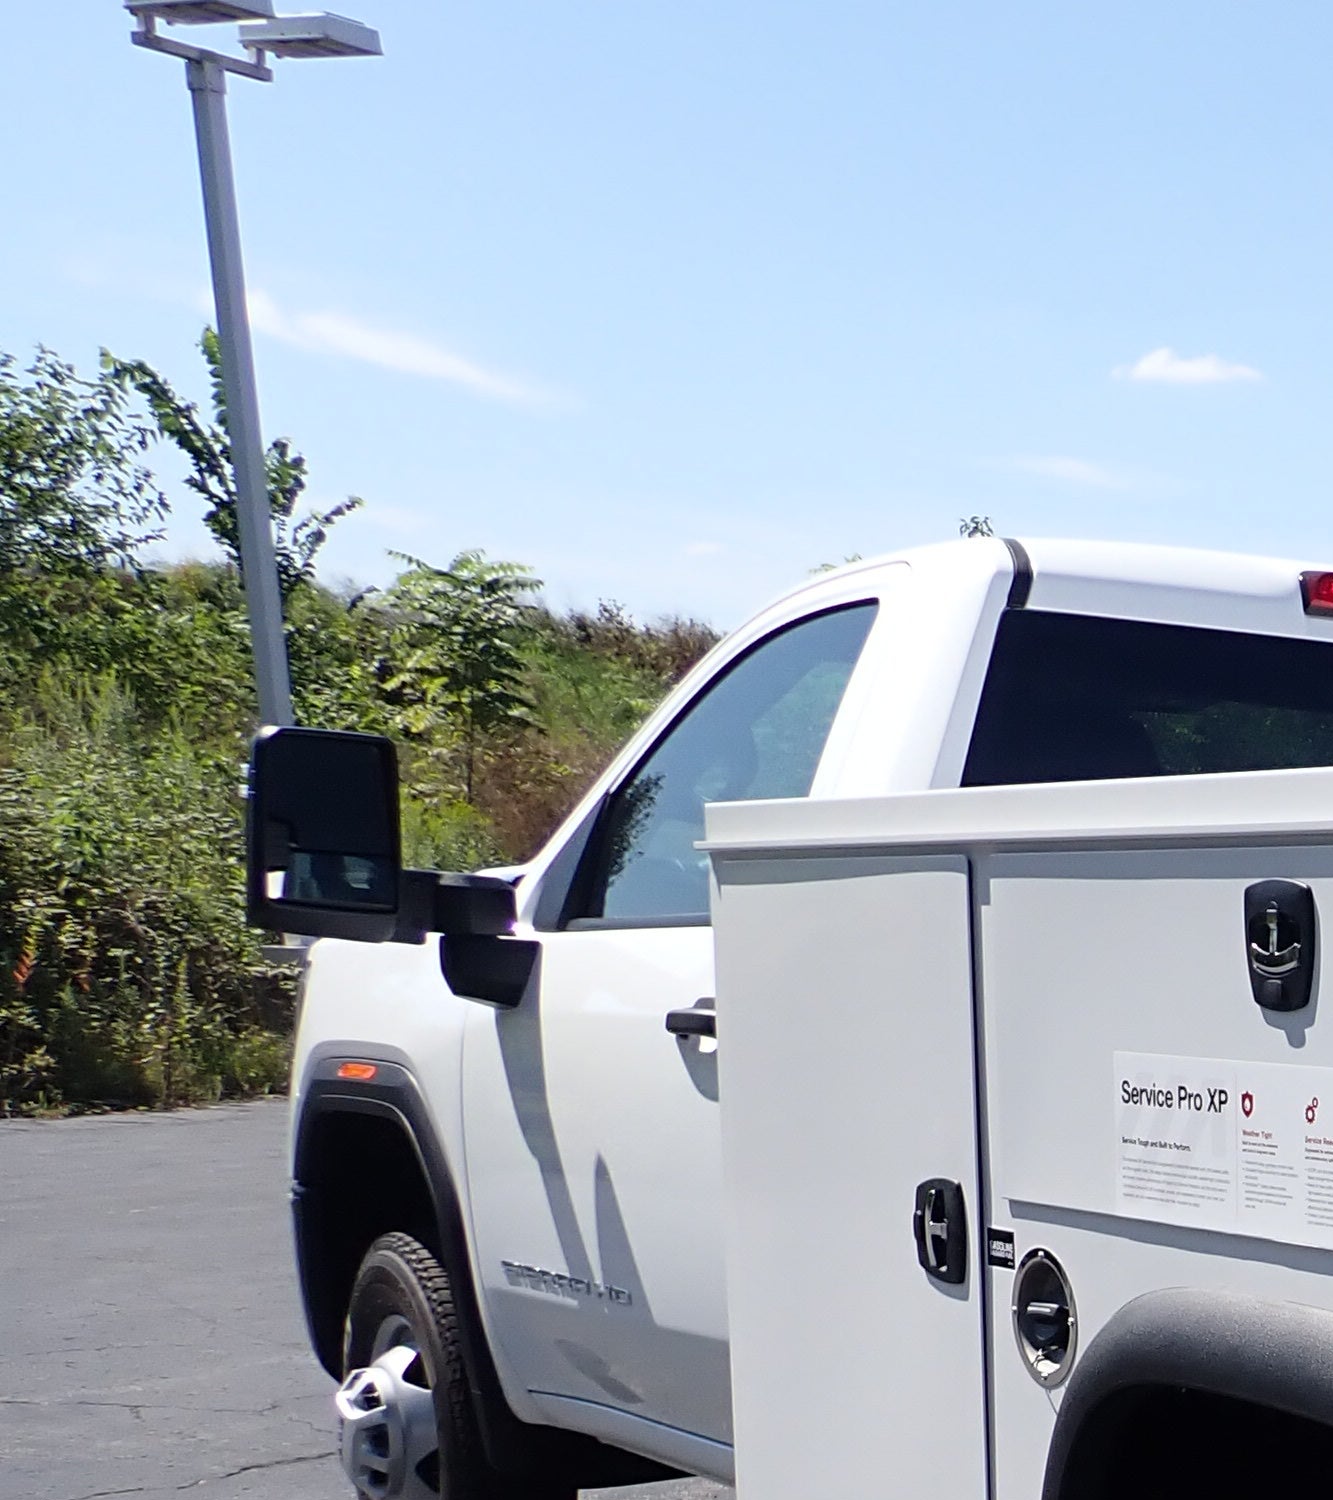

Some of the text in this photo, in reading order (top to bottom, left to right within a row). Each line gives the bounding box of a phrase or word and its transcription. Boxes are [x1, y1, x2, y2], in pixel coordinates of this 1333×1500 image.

[1121, 1080, 1229, 1113] Service Pro XP
